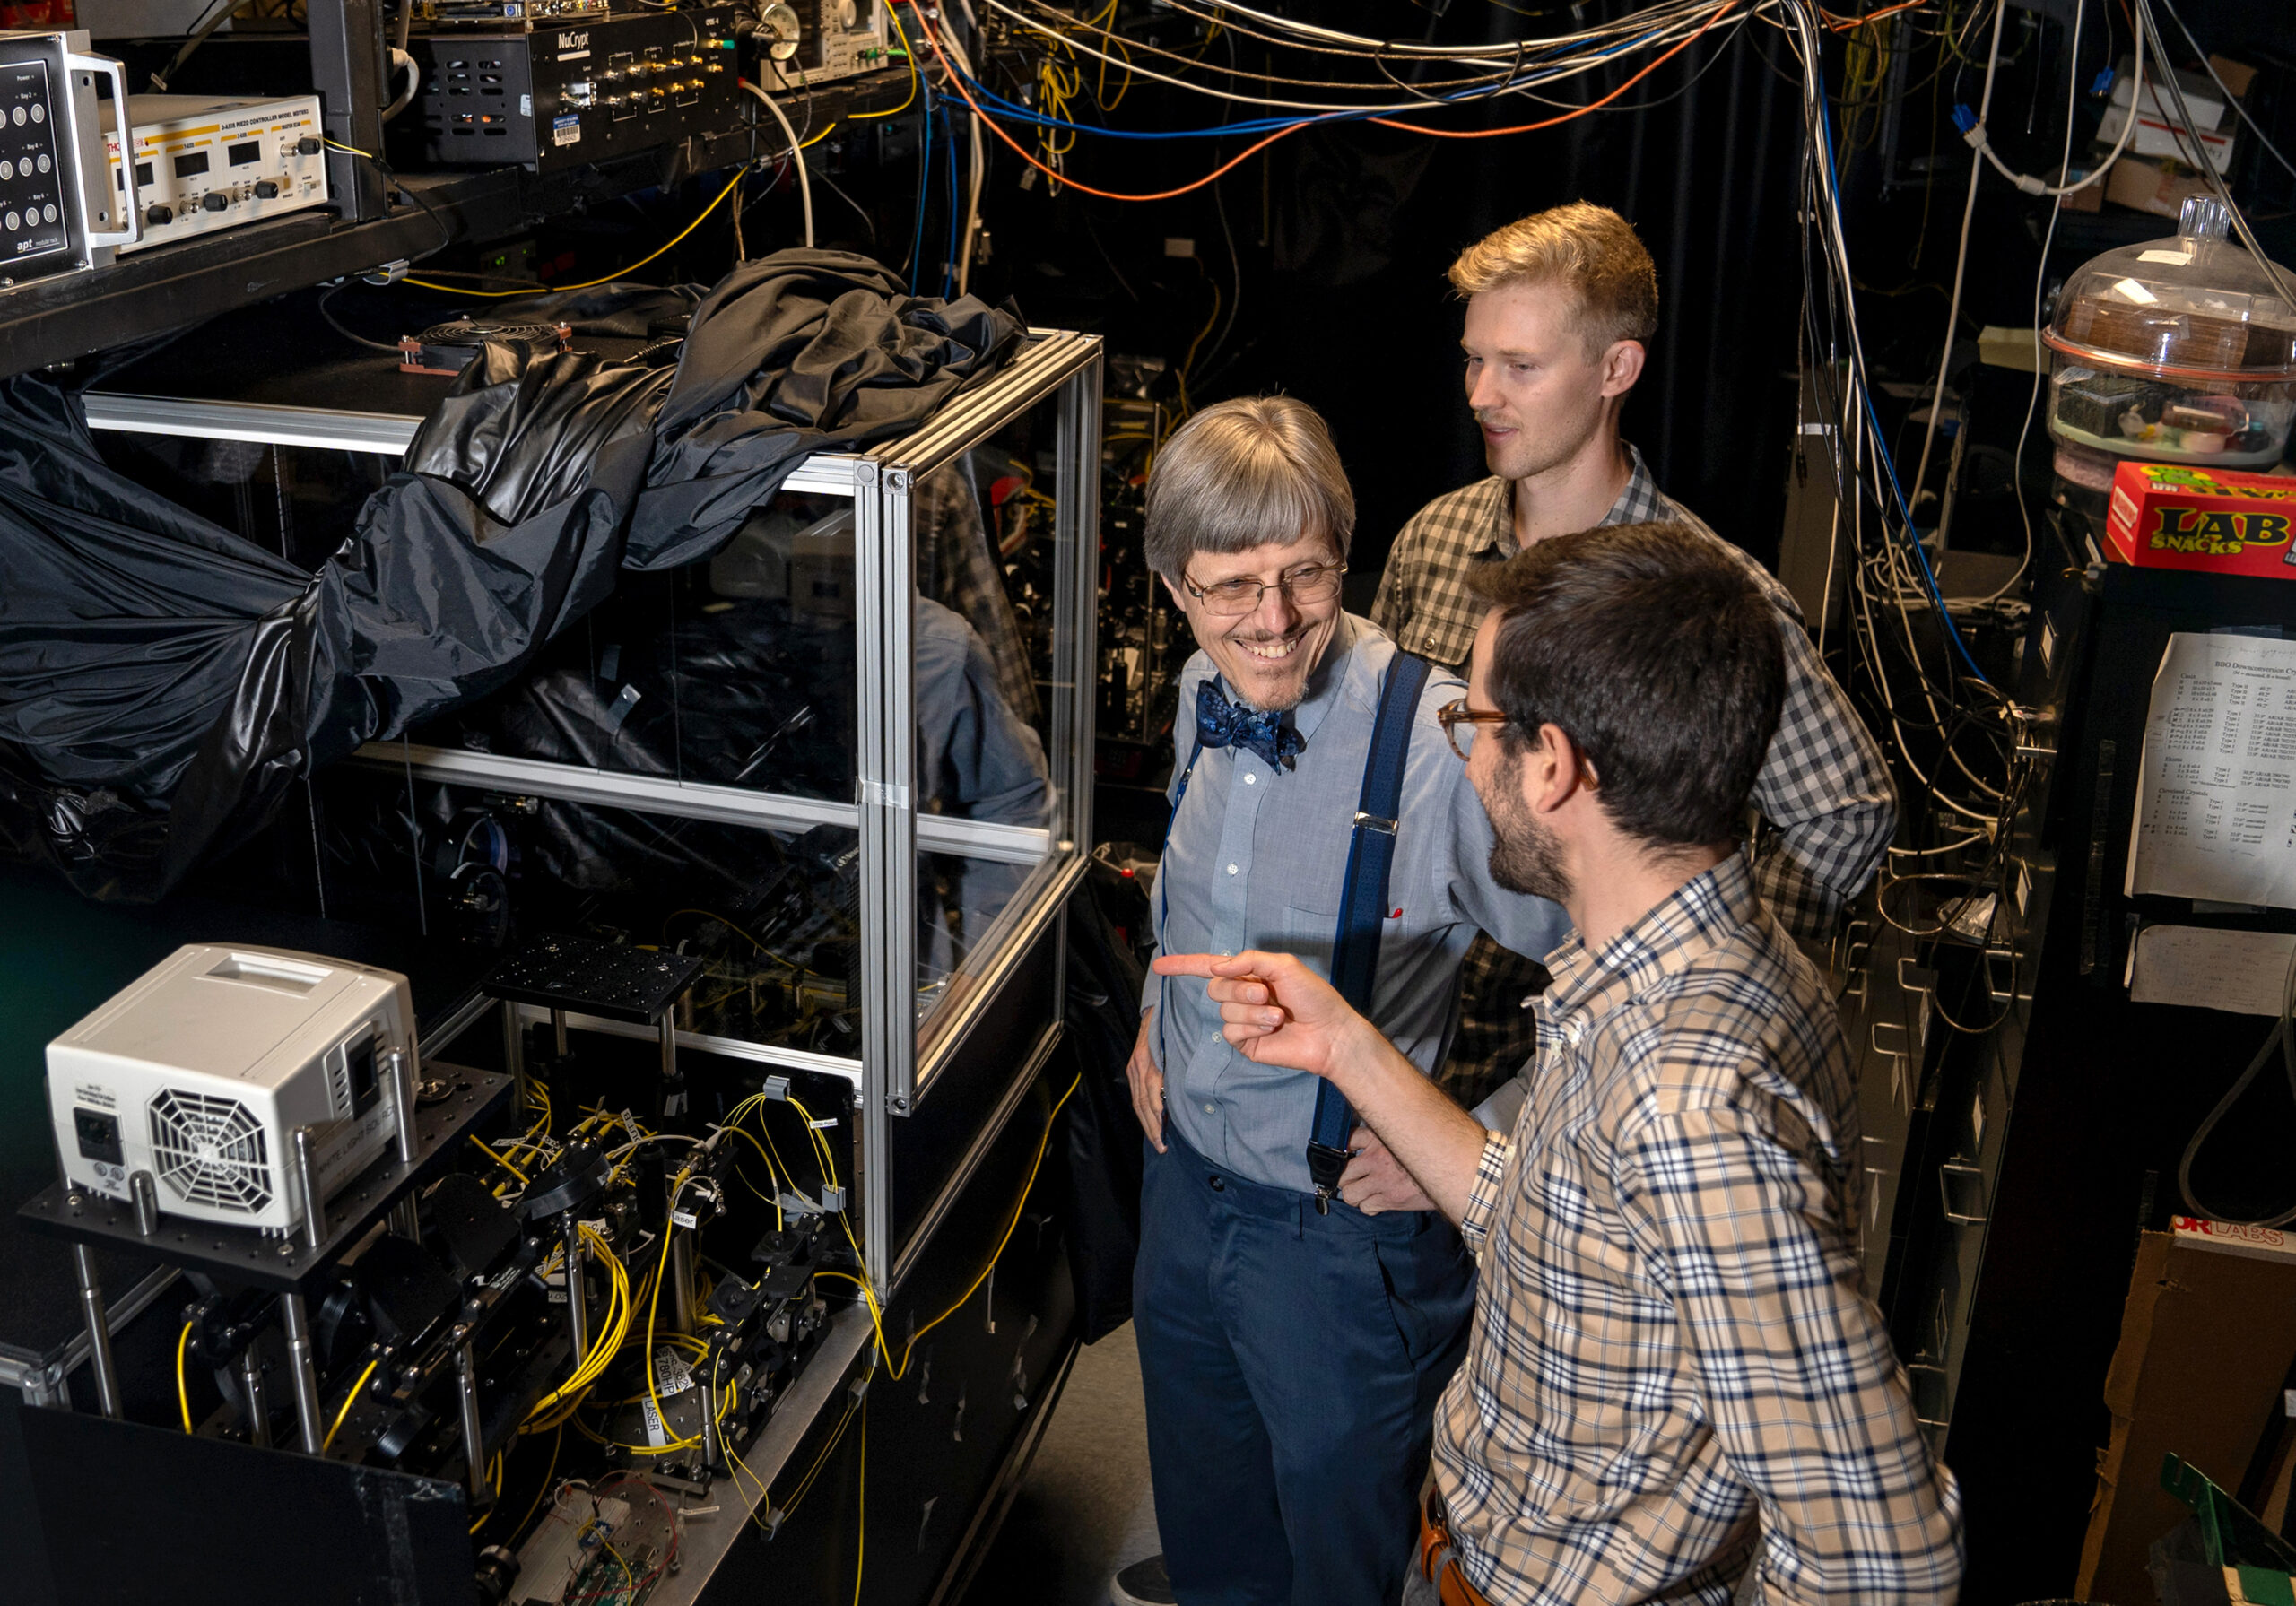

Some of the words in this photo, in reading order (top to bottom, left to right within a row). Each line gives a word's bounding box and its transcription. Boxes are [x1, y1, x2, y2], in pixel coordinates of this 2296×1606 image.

[558, 31, 589, 50] NuCrypt
[250, 115, 277, 125] CONTROLLER
[17, 239, 32, 251] apt
[2154, 507, 2291, 546] LAB
[2150, 531, 2243, 555] SNACKS
[2232, 663, 2284, 673] Downconversion
[343, 1129, 364, 1156] LIGHT
[366, 1106, 395, 1134] SOURC
[658, 1359, 674, 1393] 780HP
[645, 1400, 660, 1431] LASER
